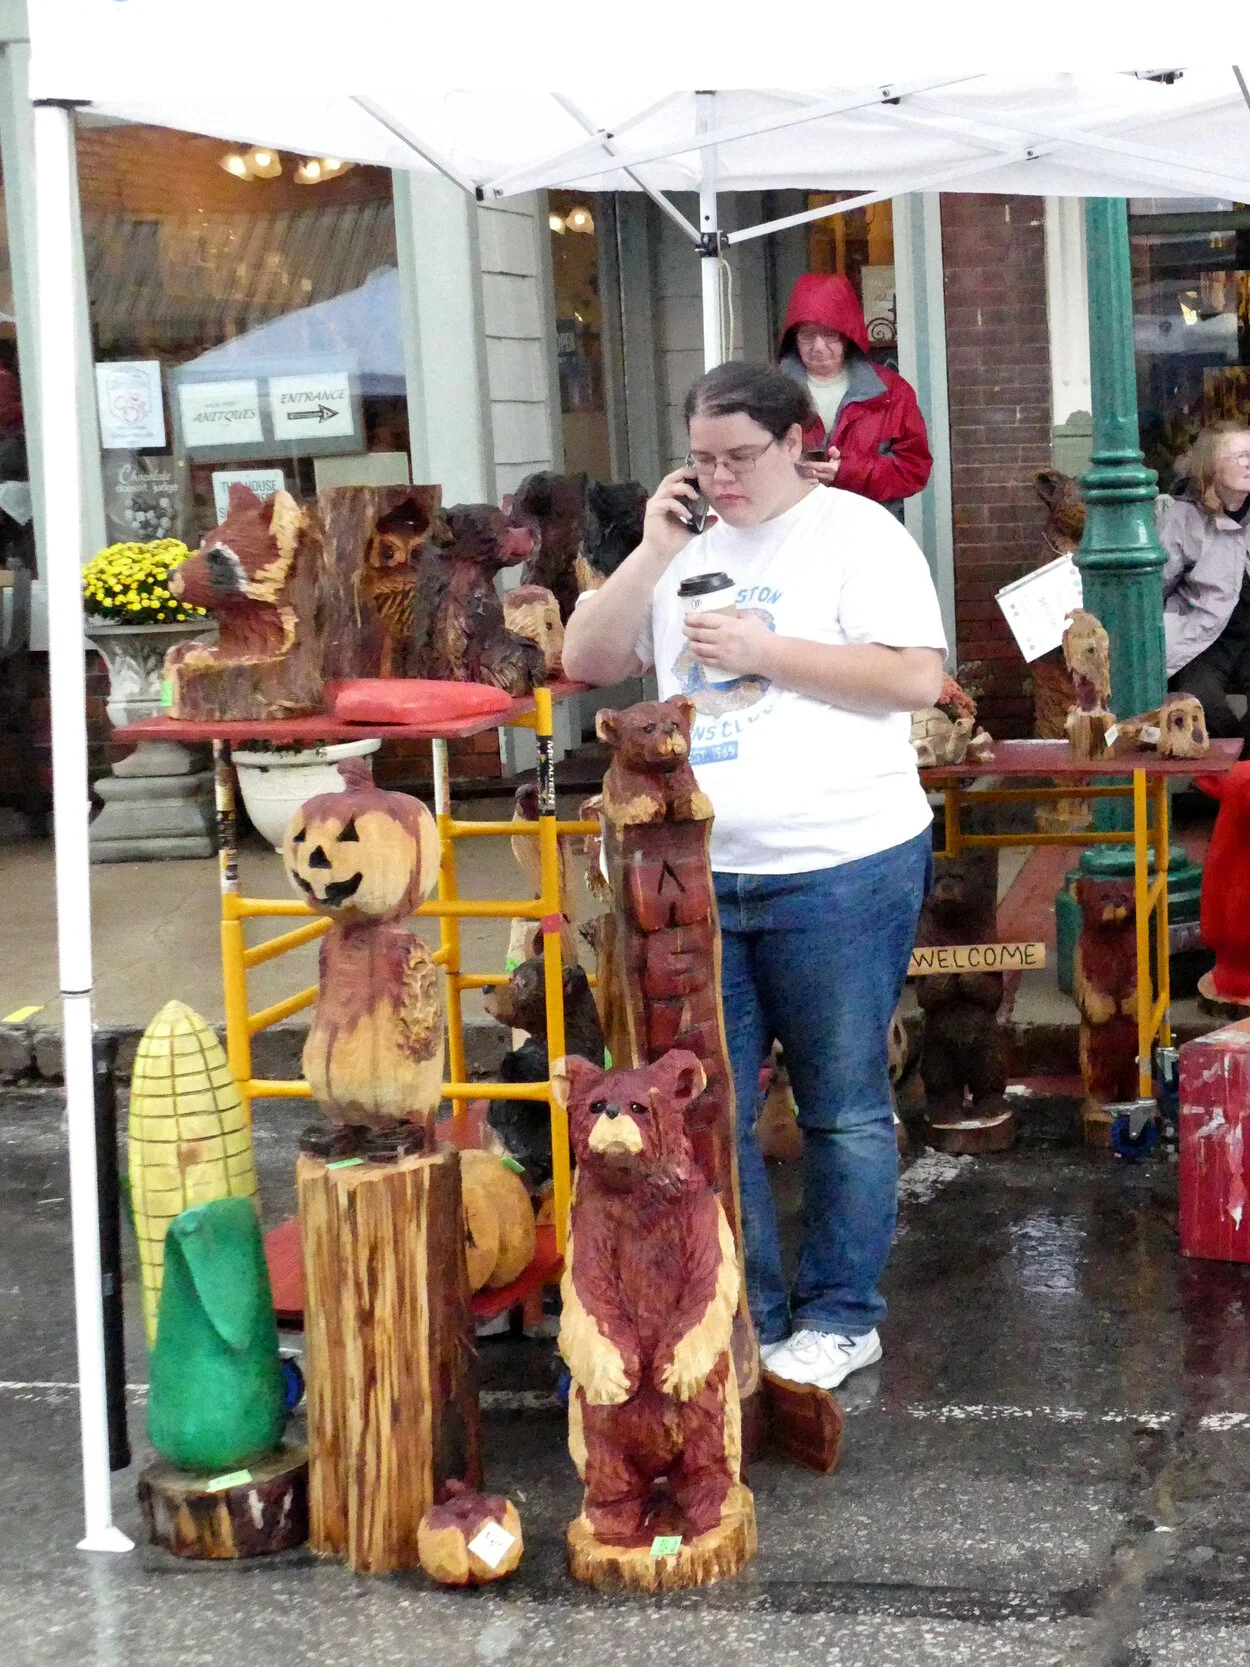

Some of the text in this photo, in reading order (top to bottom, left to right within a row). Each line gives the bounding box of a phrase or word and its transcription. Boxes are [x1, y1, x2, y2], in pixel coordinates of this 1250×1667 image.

[281, 389, 346, 404] ENTRANCE
[735, 586, 784, 604] STON
[692, 725, 717, 742] NS
[912, 943, 1036, 968] WELCOME
